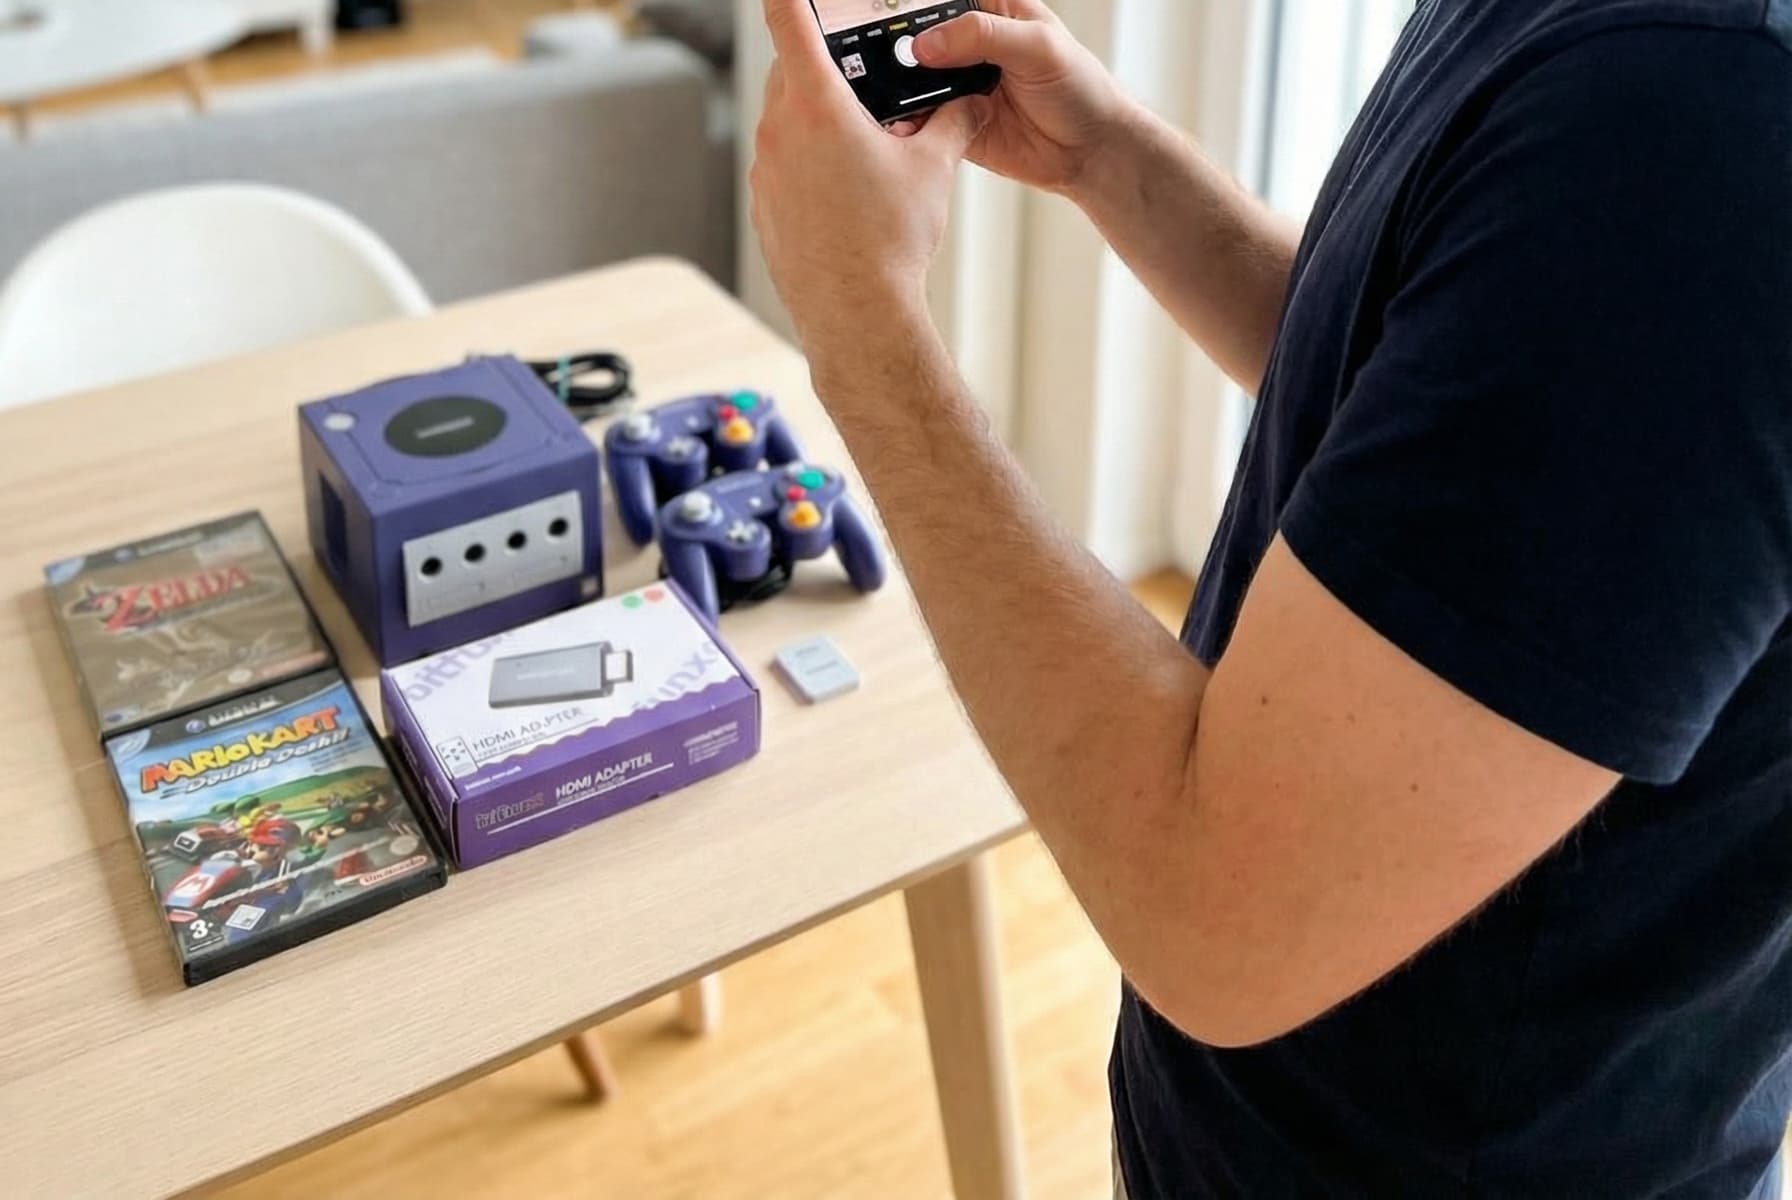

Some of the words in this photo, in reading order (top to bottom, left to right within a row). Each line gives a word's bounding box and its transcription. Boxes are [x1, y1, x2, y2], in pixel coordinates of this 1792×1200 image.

[95, 566, 256, 633] ZELDA
[472, 730, 516, 751] HDMI
[555, 774, 592, 799] HDMI
[595, 752, 653, 784] ADAPTER
